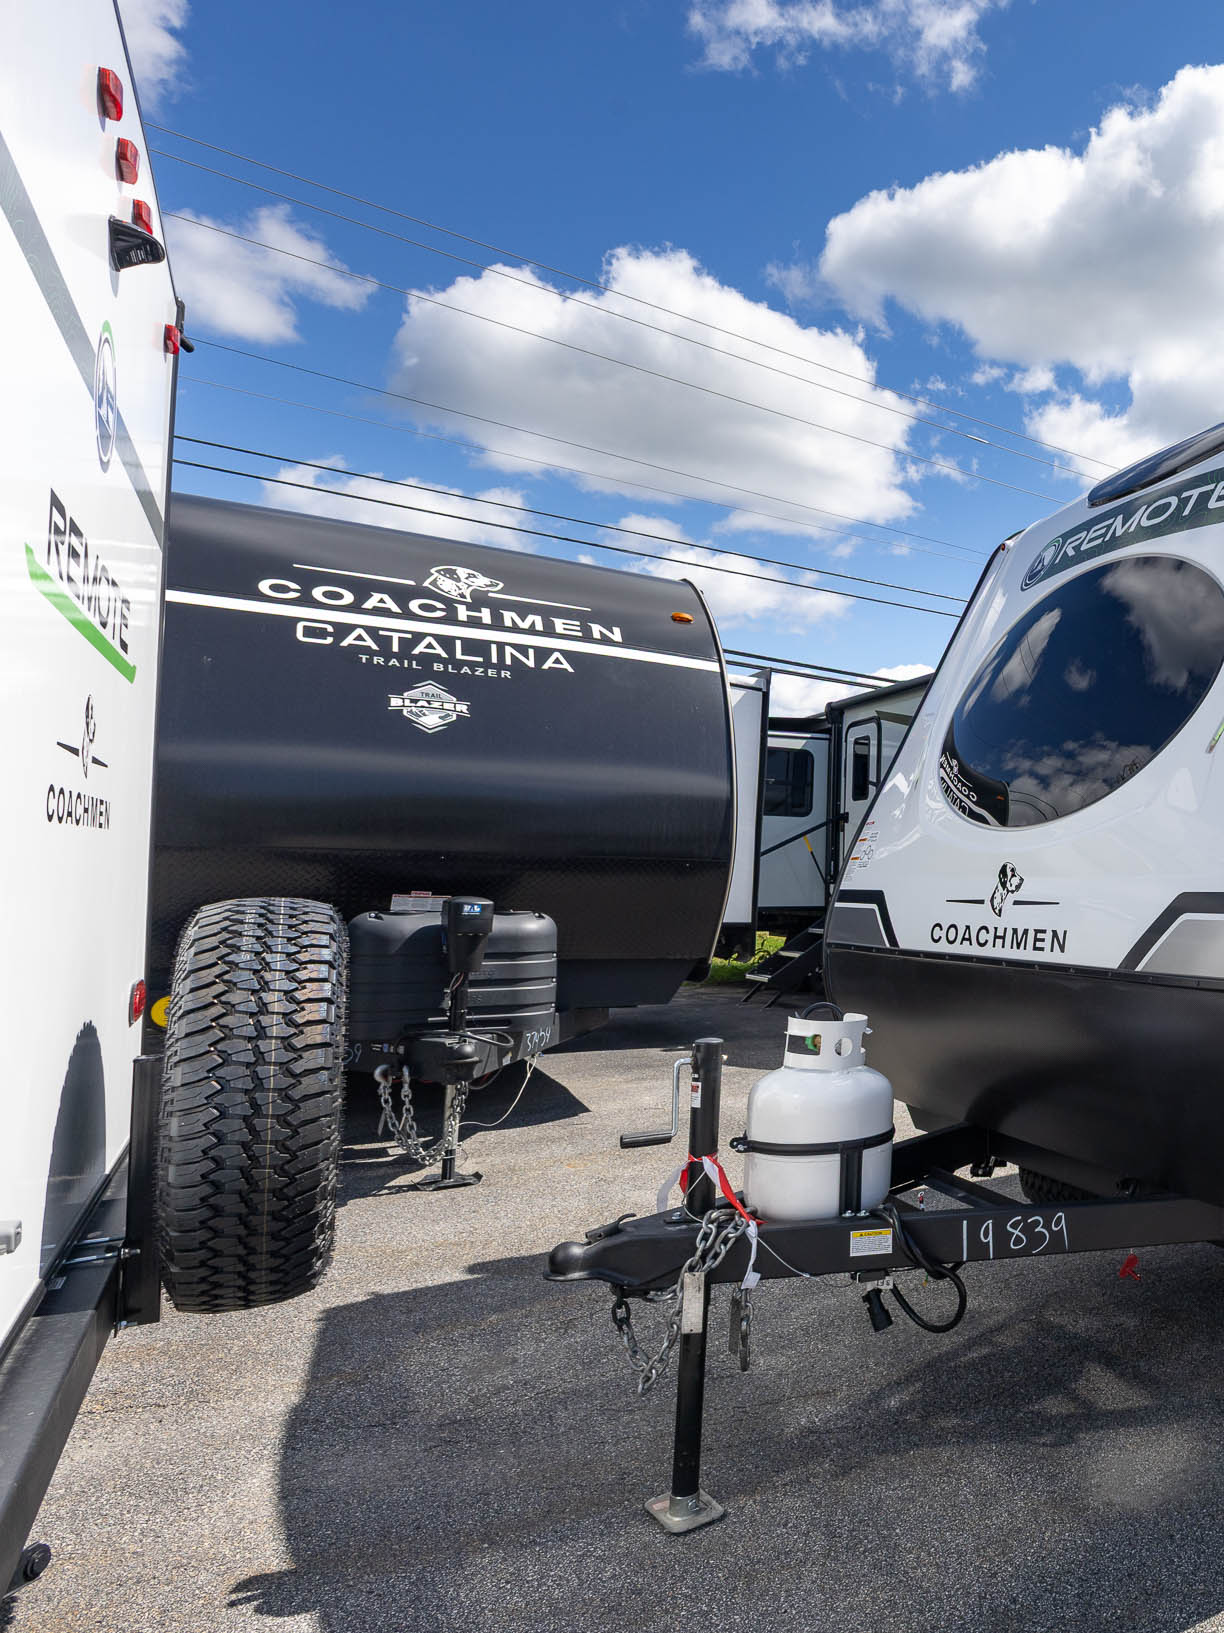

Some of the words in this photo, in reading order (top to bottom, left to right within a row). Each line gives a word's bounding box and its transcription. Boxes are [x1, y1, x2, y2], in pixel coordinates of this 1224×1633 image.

[47, 487, 131, 655] REMOTE
[257, 578, 624, 643] COACHMEN
[295, 621, 575, 673] CATALINA
[359, 654, 423, 671] TRAIL
[433, 663, 512, 679] BLAZER
[390, 697, 470, 713] BLAZER
[420, 691, 442, 699] TRAIL
[46, 783, 110, 830] COACHMEN
[930, 922, 1067, 953] COACHMEN
[962, 1212, 1069, 1261] 19839
